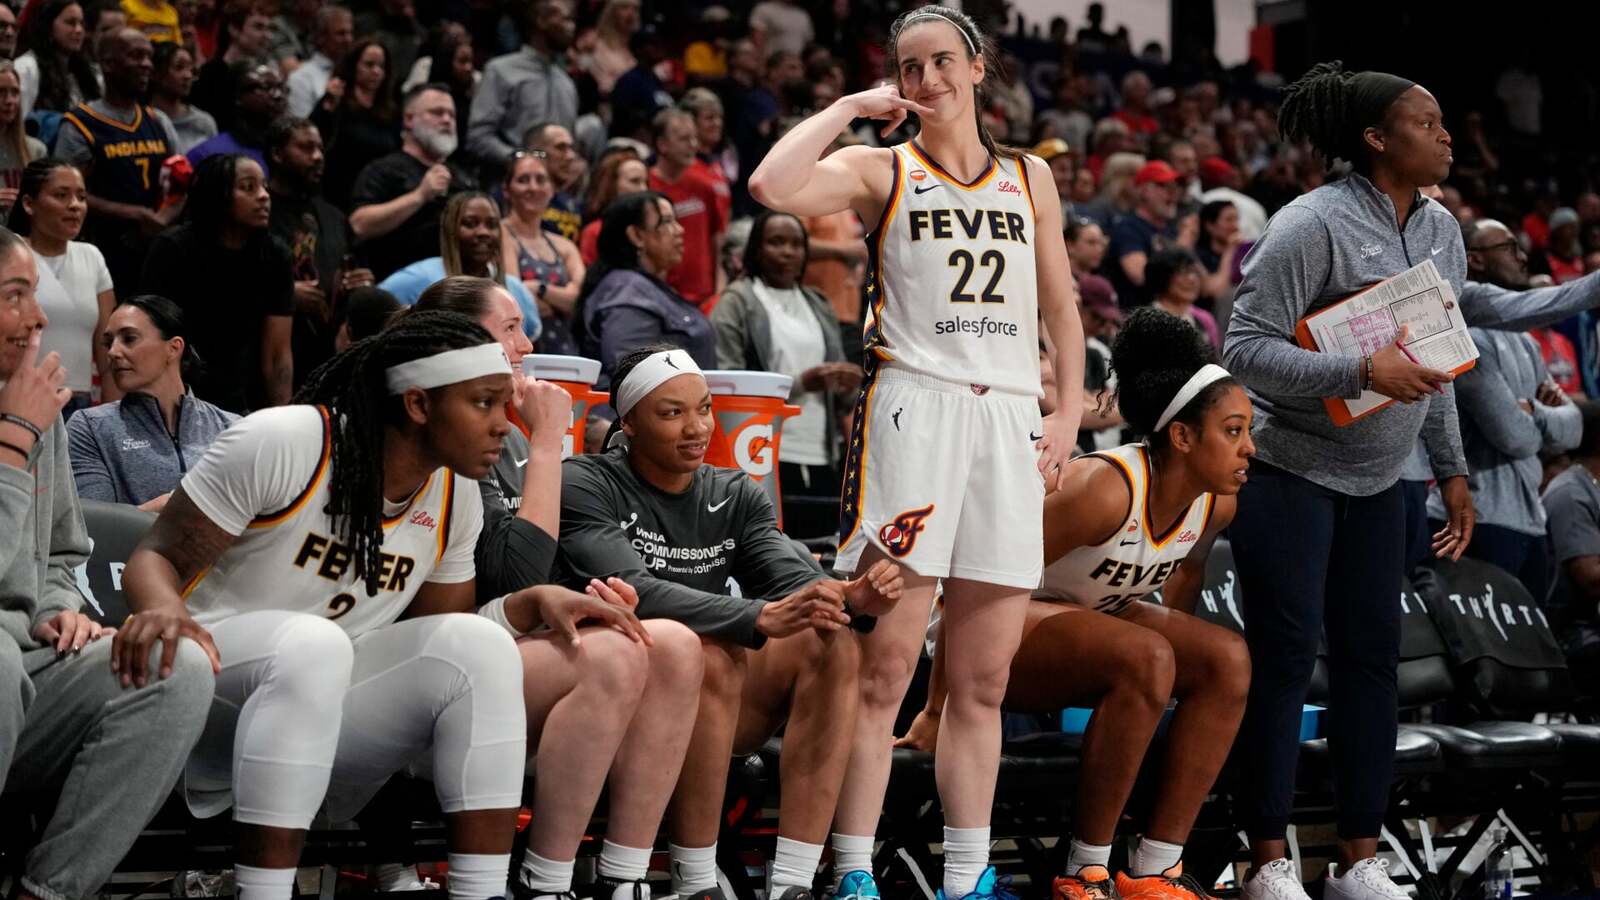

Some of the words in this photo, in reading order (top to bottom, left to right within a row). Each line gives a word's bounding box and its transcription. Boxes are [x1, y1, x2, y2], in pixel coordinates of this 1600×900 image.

[104, 140, 166, 159] INDIANA
[135, 157, 150, 189] 7
[998, 181, 1021, 197] Lilly
[909, 208, 1028, 245] FEVER
[948, 249, 1005, 303] 22
[935, 315, 1018, 338] salesforce
[734, 424, 773, 476] G
[409, 511, 437, 532] Lilly
[293, 531, 416, 592] FEER
[631, 538, 735, 560] COMMISSONE'S
